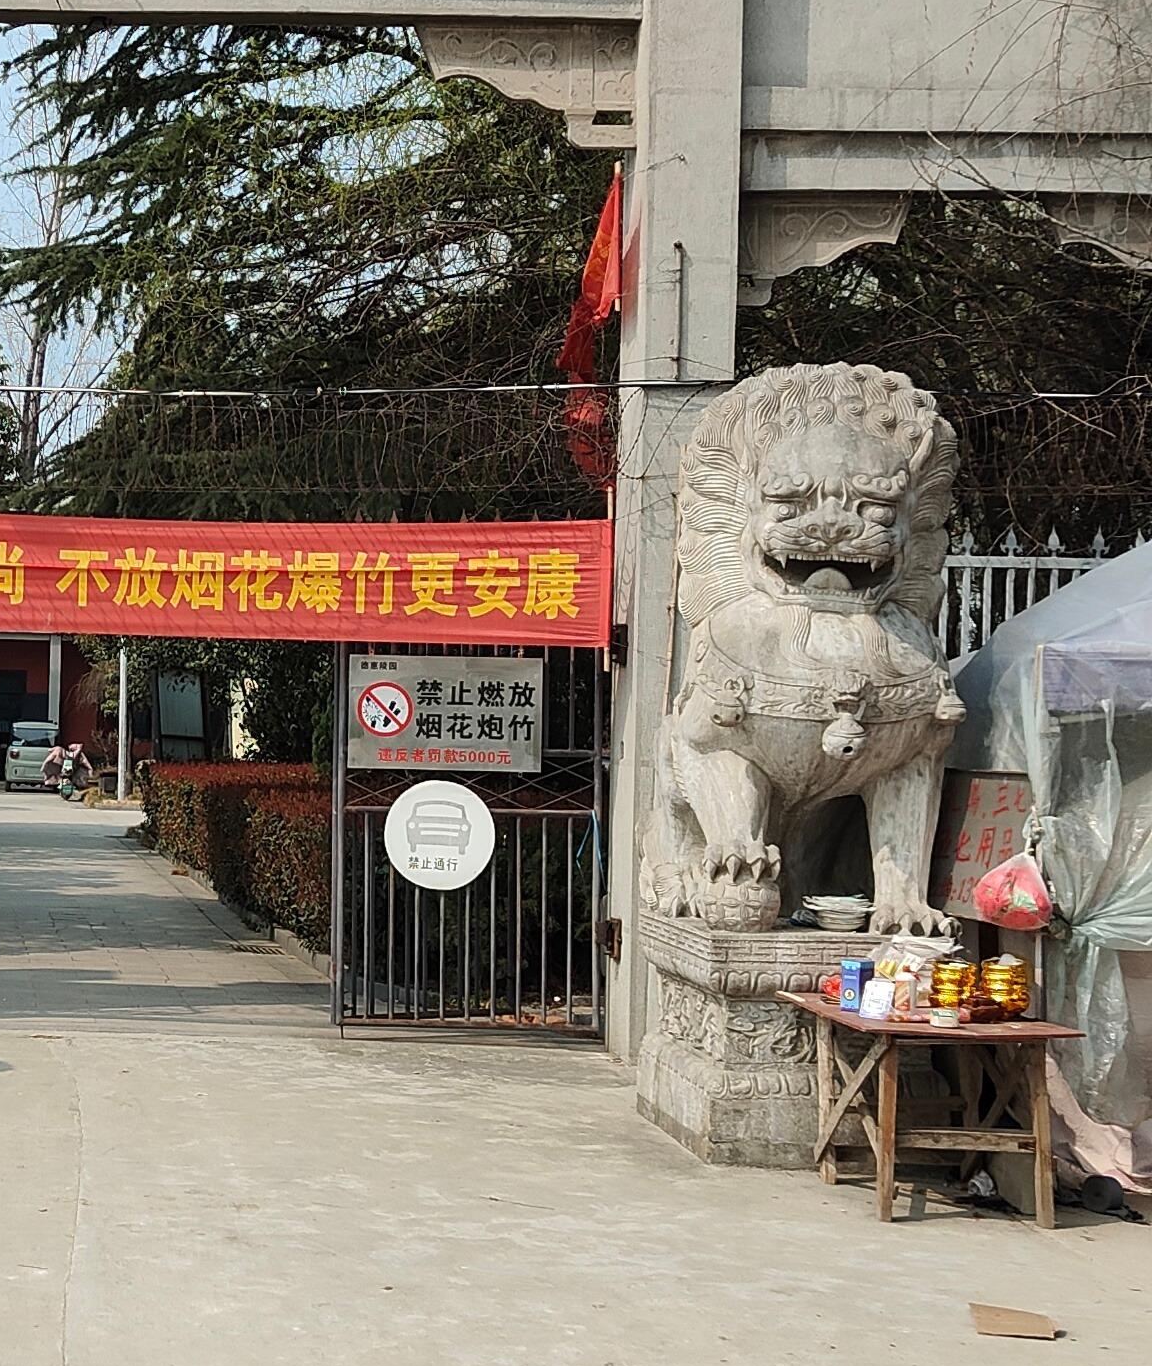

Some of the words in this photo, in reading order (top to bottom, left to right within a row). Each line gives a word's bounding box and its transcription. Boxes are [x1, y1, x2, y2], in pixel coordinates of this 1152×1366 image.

[55, 546, 582, 620] 不放烟花爆竹更安康
[360, 660, 398, 671] 德惠陵园
[416, 678, 536, 708] 禁止燃放
[415, 712, 535, 742] 烟花炮竹
[377, 747, 512, 765] 违反者罚款5000元
[408, 855, 459, 872] 禁止通行
